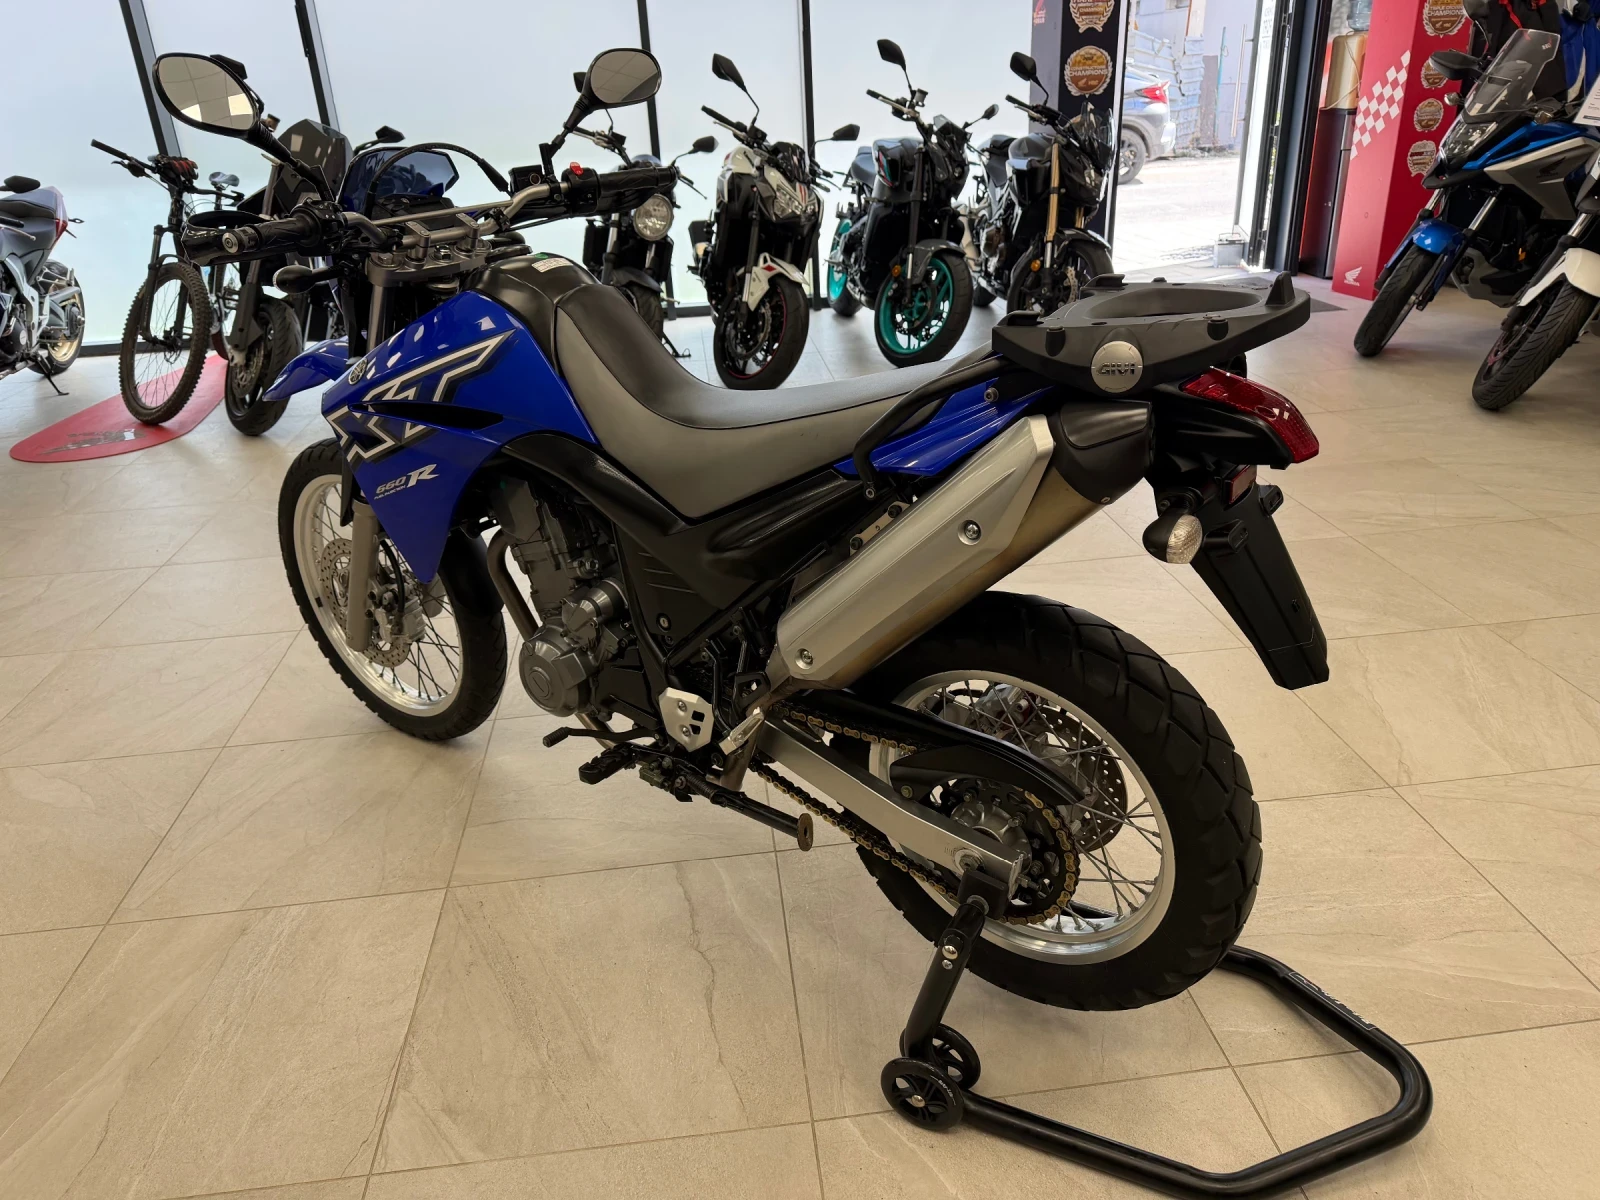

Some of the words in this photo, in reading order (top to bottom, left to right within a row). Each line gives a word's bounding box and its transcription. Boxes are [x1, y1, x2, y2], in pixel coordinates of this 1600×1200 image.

[1427, 9, 1464, 17] CHAMPIONS
[1069, 69, 1109, 77] CHAMPIONS
[1096, 362, 1136, 376] GIVI
[376, 475, 407, 494] 660
